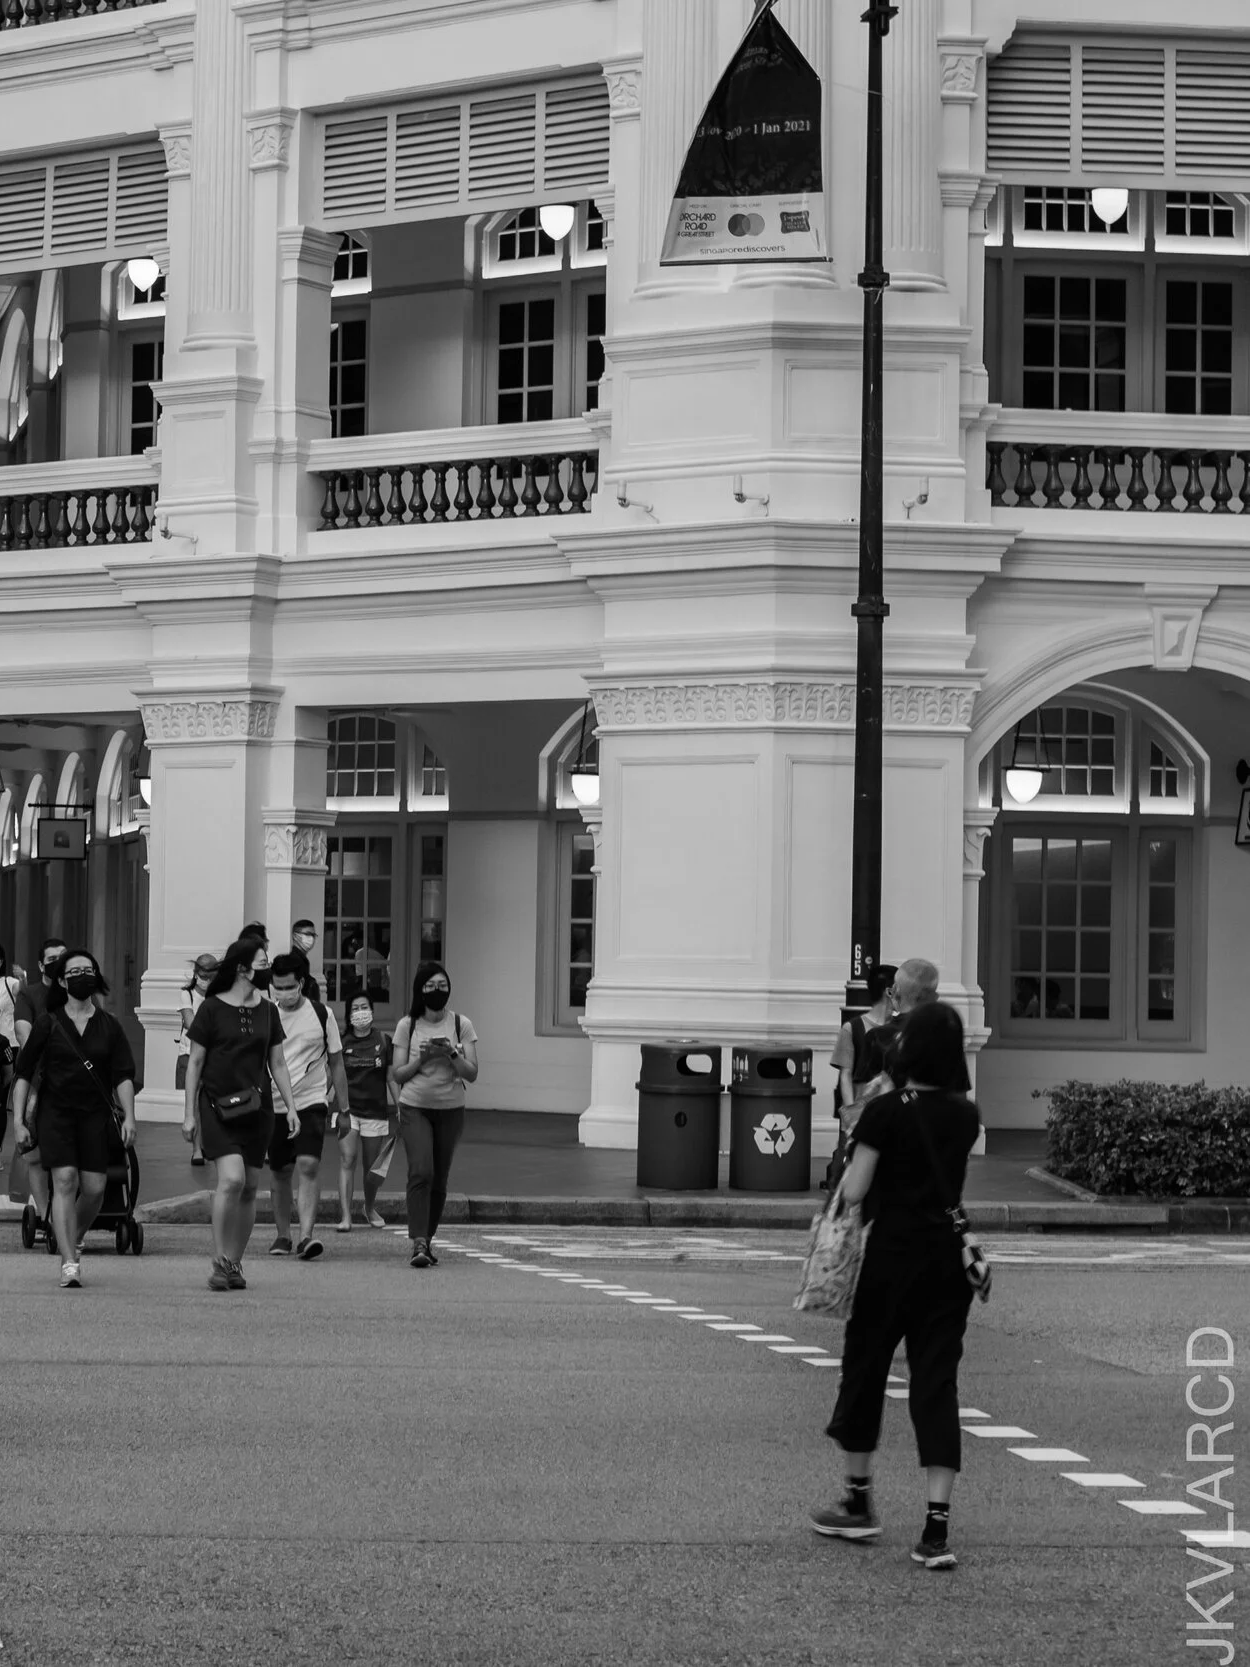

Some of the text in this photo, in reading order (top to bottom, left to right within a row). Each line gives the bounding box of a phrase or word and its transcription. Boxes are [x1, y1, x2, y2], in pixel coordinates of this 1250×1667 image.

[753, 124, 758, 134] 1
[761, 122, 780, 136] Jan
[784, 120, 811, 132] 2021
[679, 212, 716, 221] ORCHARD
[685, 222, 708, 230] ROAD
